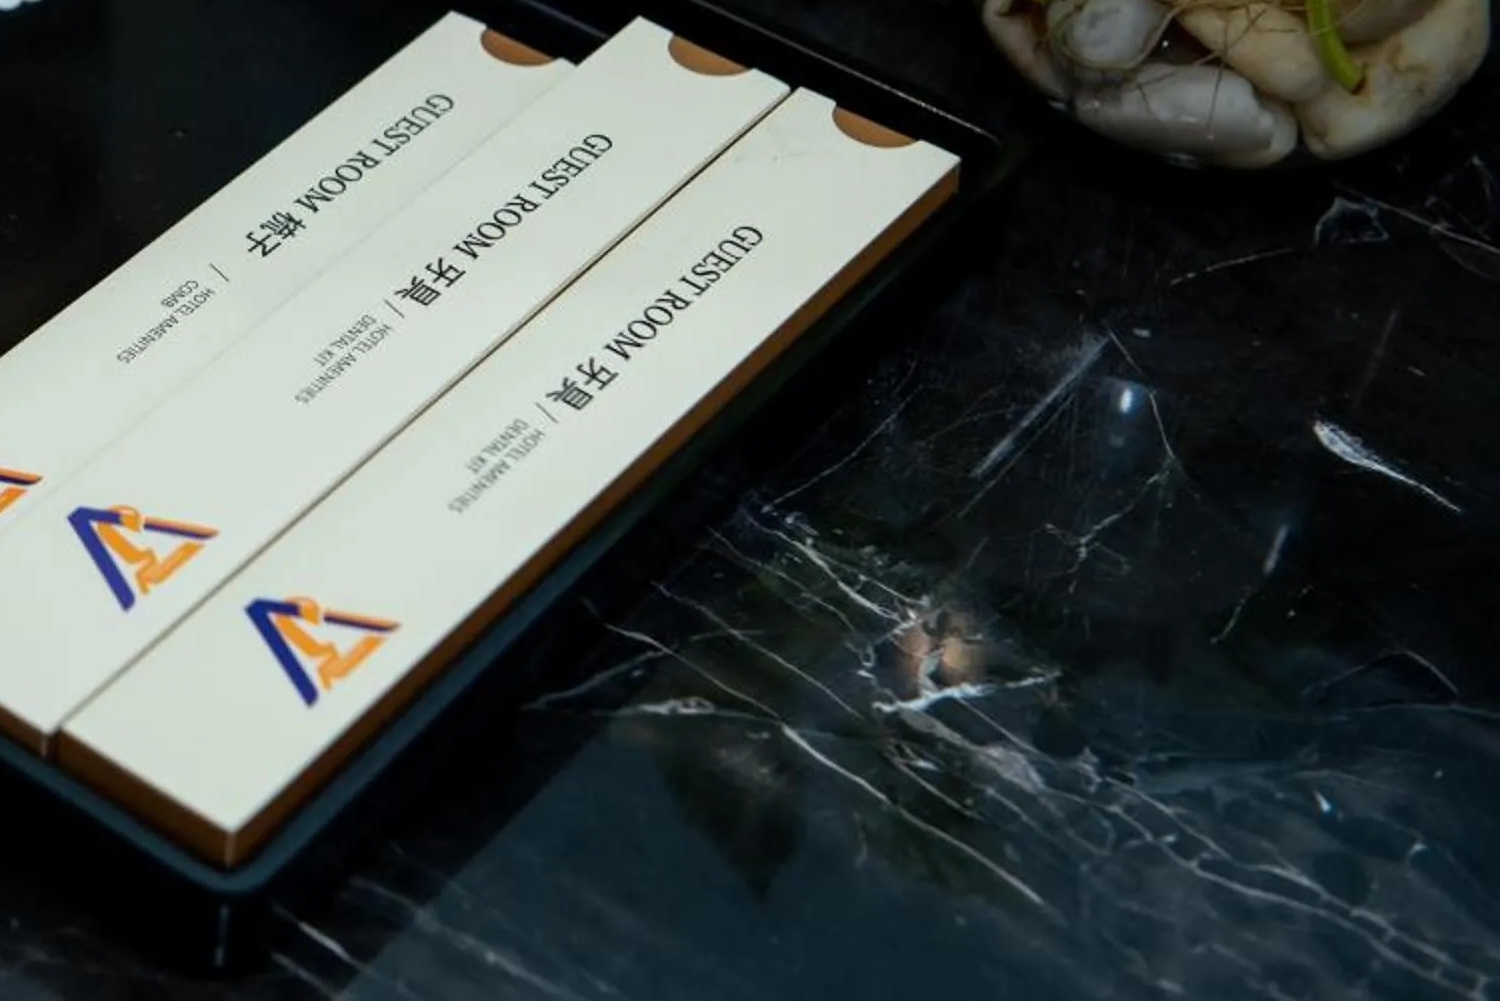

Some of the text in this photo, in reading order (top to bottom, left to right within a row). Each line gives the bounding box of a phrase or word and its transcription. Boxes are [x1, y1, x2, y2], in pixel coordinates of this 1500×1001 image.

[245, 93, 455, 257] GUEST ROOM 梳子
[394, 133, 613, 306] GUEST ROOM 牙具
[116, 288, 216, 364] HOTEL AMENITIES
[160, 279, 199, 308] COMB
[329, 314, 377, 350] DENTAL
[545, 225, 764, 410] GUEST ROOM 牙具
[294, 323, 392, 403] HOTEL AMENITIES
